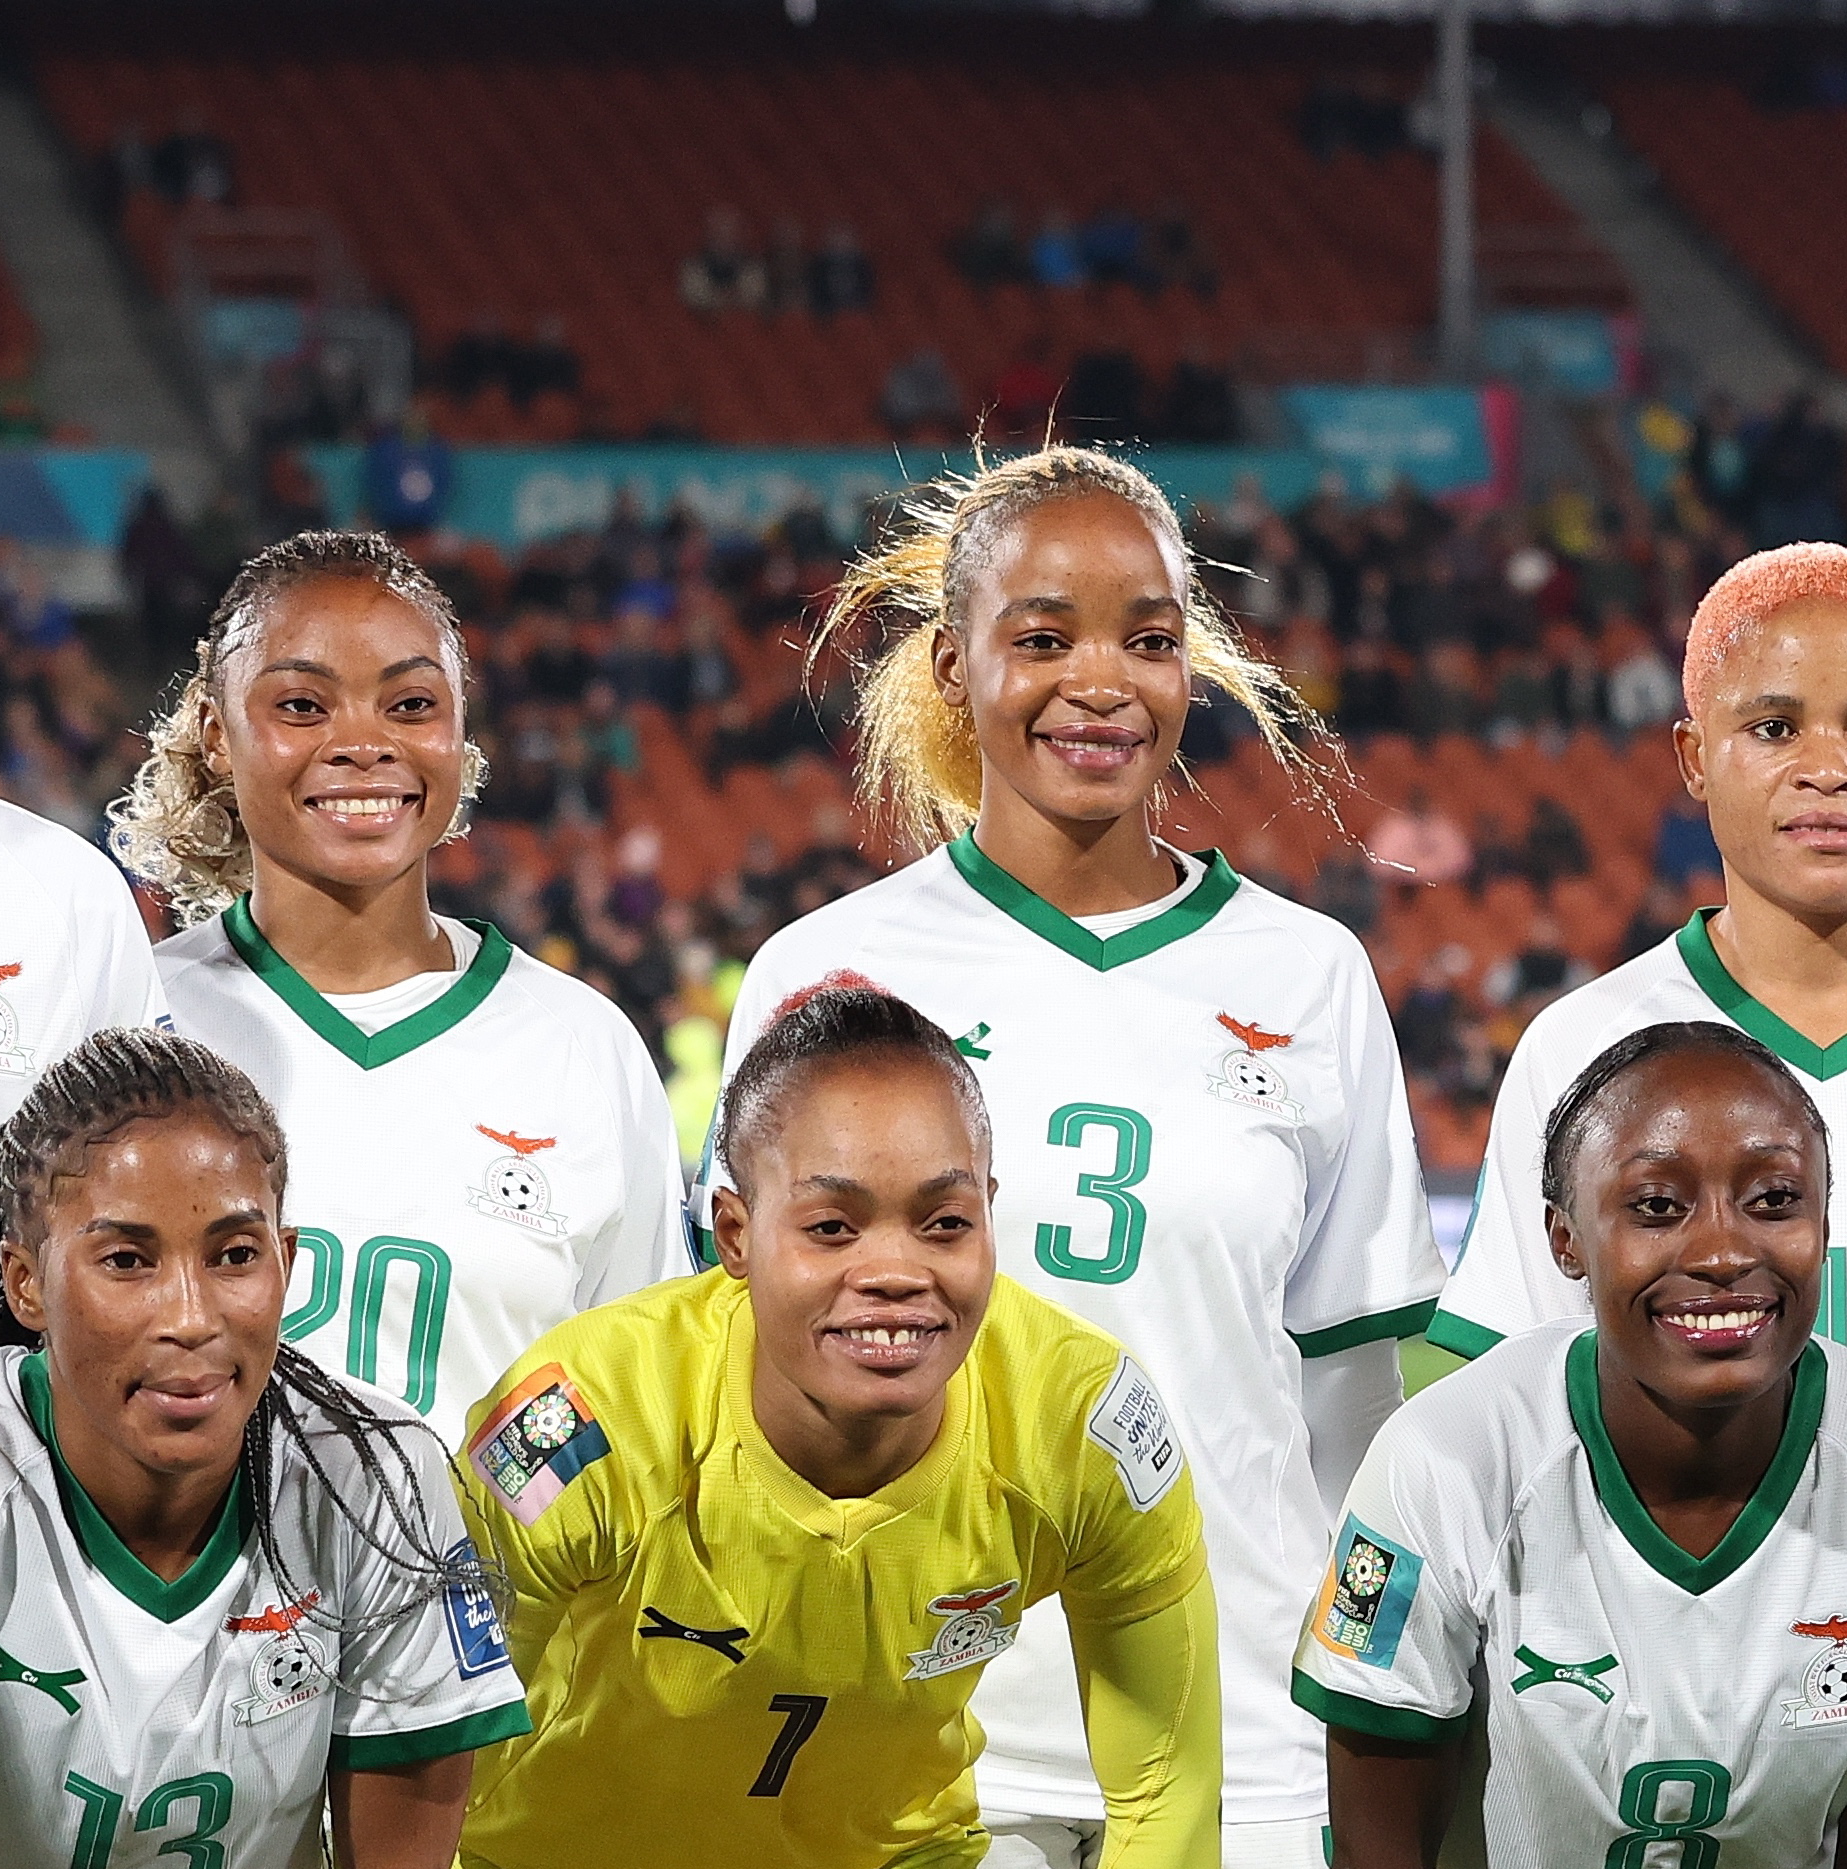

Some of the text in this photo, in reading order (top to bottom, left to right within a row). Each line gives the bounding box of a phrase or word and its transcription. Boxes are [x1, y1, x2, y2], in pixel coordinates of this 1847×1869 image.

[1233, 1092, 1284, 1114] ZAMBIA
[1035, 1103, 1152, 1285] 3
[492, 1204, 543, 1229] ZAMBIA
[1113, 1382, 1146, 1431] FOOTBALL
[1127, 1390, 1158, 1444] UNITES
[509, 1422, 522, 1440] FIFA
[490, 1442, 508, 1463] AU
[511, 1451, 529, 1469] CUP
[1132, 1442, 1150, 1465] the
[1154, 1443, 1170, 1468] FIFA
[496, 1472, 519, 1495] 23
[505, 1462, 526, 1484] 20
[465, 1606, 492, 1629] the
[1351, 1610, 1364, 1620] CUP
[1344, 1619, 1368, 1635] 20
[1340, 1632, 1364, 1648] 23
[938, 1646, 985, 1668] ZAMBIA
[266, 1685, 320, 1716] ZAMBIA
